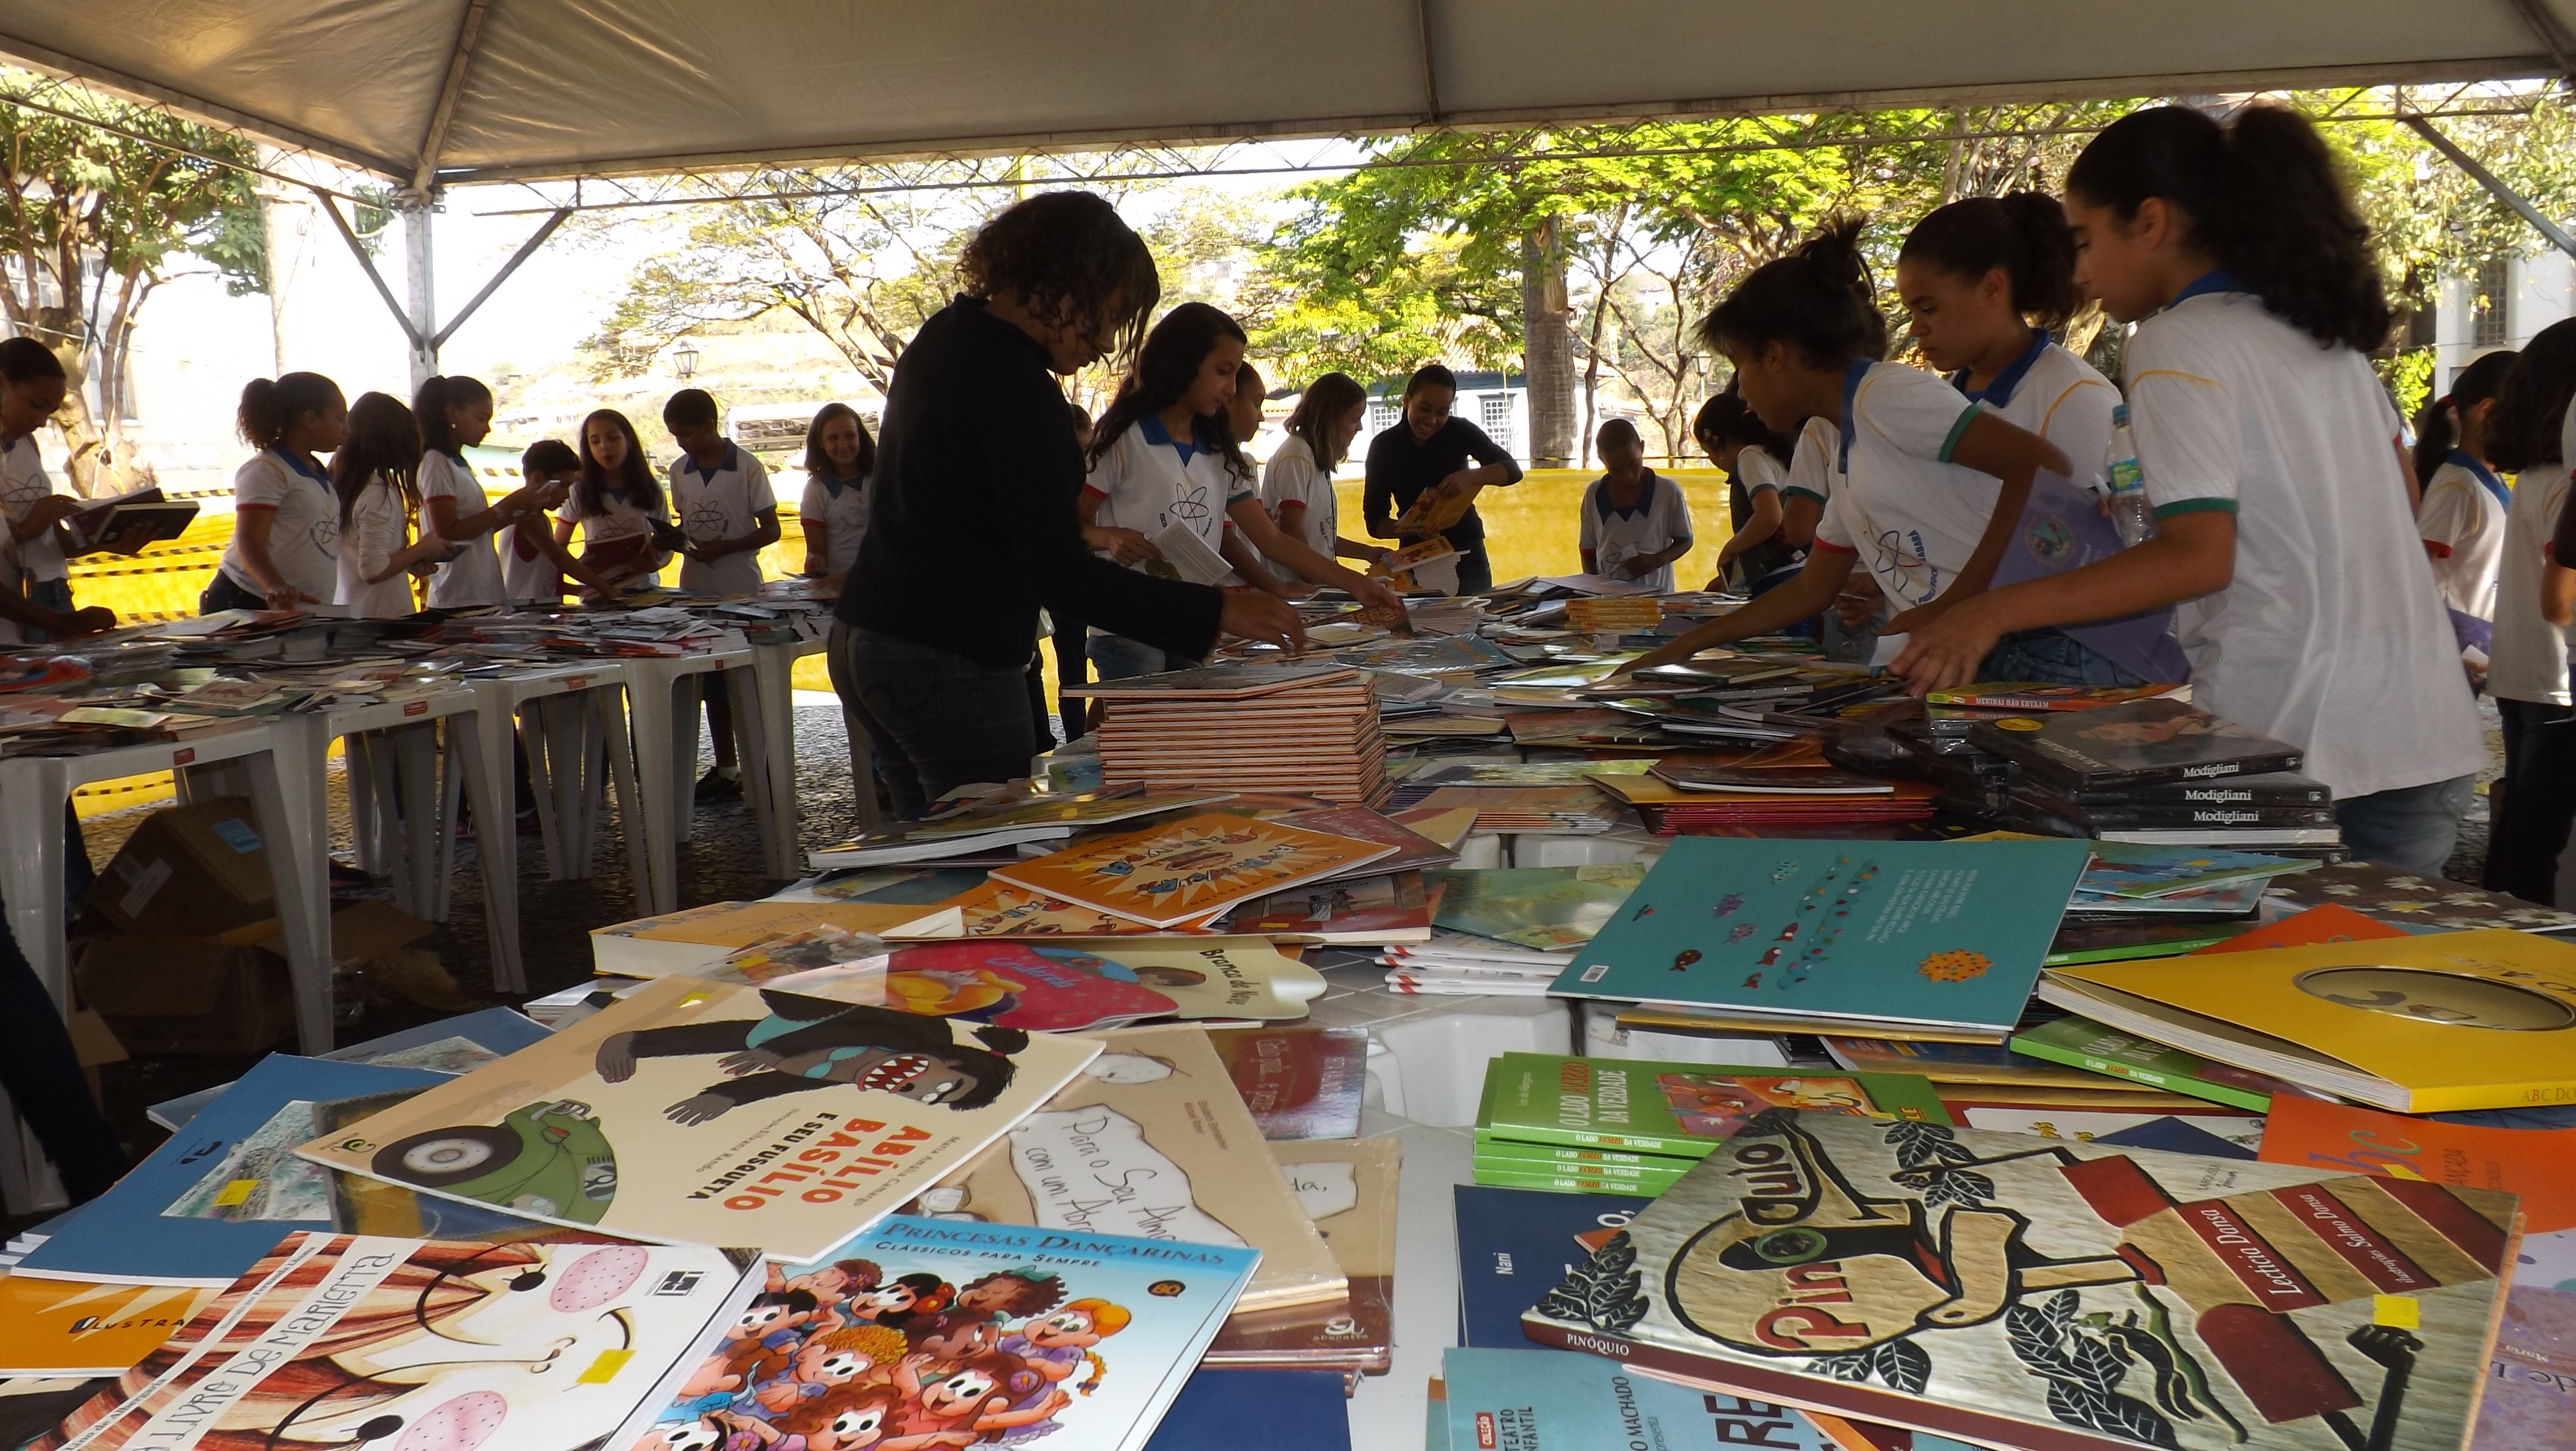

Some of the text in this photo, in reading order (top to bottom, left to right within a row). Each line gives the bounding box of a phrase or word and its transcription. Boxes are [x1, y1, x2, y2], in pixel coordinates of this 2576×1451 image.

[1975, 697, 2049, 709] MENINAS NÃO ENTRAM
[2183, 761, 2240, 778] Modigliani
[2184, 789, 2252, 804] Modigliani
[2193, 810, 2259, 825] Modigliani
[1198, 948, 1260, 1007] Branca de Neve
[1560, 1095, 1590, 1119] LADO
[1597, 1070, 1629, 1124] DA VERDADE
[2522, 1088, 2551, 1103] ABC
[685, 1112, 839, 1200] E SEU FUSQUETA
[1624, 1138, 1633, 1147] DA
[1633, 1139, 1662, 1150] VERDADE
[696, 1153, 732, 1173] Rando
[723, 1118, 887, 1211] BASÍLIO
[800, 1125, 933, 1204] ABÍLIO
[853, 1135, 961, 1207] Maria Amália Camargo
[1025, 1147, 1055, 1172] com
[1040, 1175, 1069, 1196] um
[1061, 1114, 1111, 1157] Para
[1093, 1169, 1158, 1205] Seu
[1612, 1154, 1640, 1163] VERDADE
[1612, 1168, 1641, 1177] VERDADE
[1610, 1182, 1638, 1192] VERDADE
[2299, 1193, 2339, 1220] Dansa
[882, 1222, 1227, 1265] PRINCESAS DANÇARINAS
[2331, 1219, 2373, 1248] Salmo
[875, 1240, 1101, 1268] CLÁSSICOS PARA SEMPRE
[1492, 1252, 1514, 1275] Nani
[2200, 1208, 2304, 1295] Lecticia Dansa
[254, 1265, 288, 1296] Fernanda
[68, 1315, 185, 1334] ILUSTRA
[223, 1349, 283, 1377] DE
[265, 1252, 396, 1348] MARIETTA
[1566, 1333, 1630, 1356] PINÓQUIO
[2505, 1345, 2550, 1363] Maria
[65, 1378, 168, 1451] Lino de Albergaria
[1612, 1376, 1645, 1437] MACHADO
[1499, 1408, 1520, 1451] TEATRO
[1517, 1405, 1539, 1451] NFANTIL
